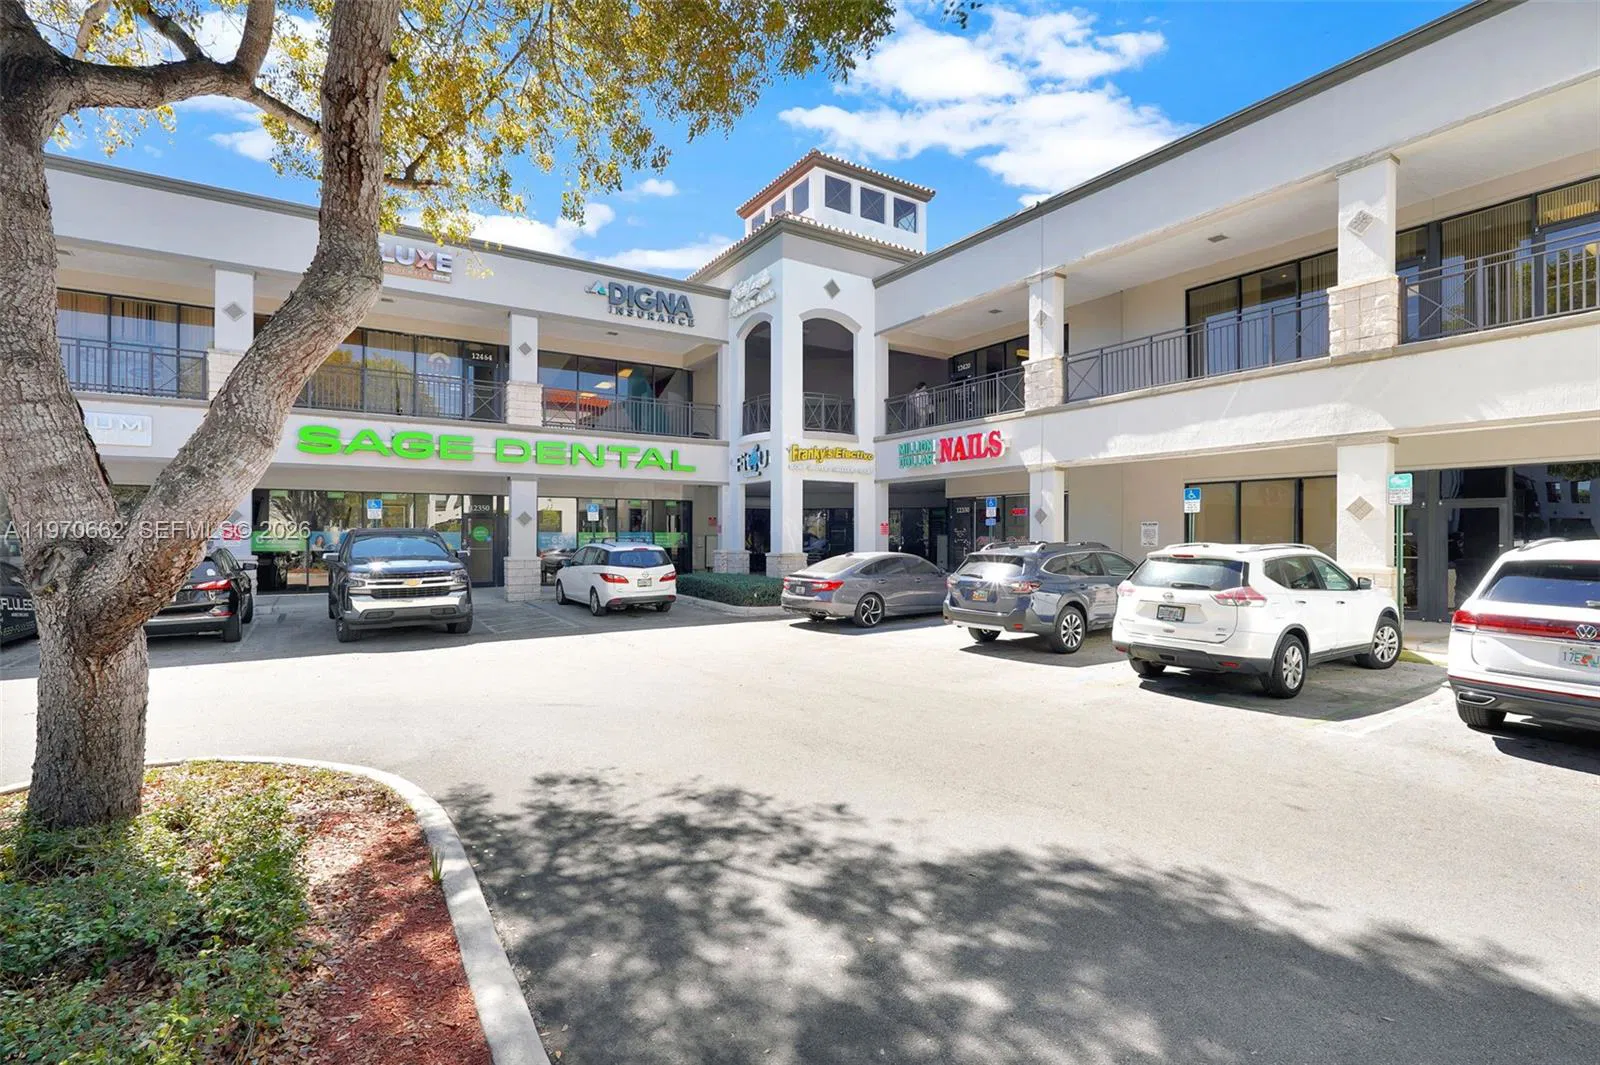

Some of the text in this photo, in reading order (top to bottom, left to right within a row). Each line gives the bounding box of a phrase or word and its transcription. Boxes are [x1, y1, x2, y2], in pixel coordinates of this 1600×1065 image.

[608, 281, 694, 318] DIGNA
[608, 305, 695, 328] INSURANCE
[297, 425, 697, 474] SAGE DENTAL
[897, 430, 1004, 463] MILLION NAILS
